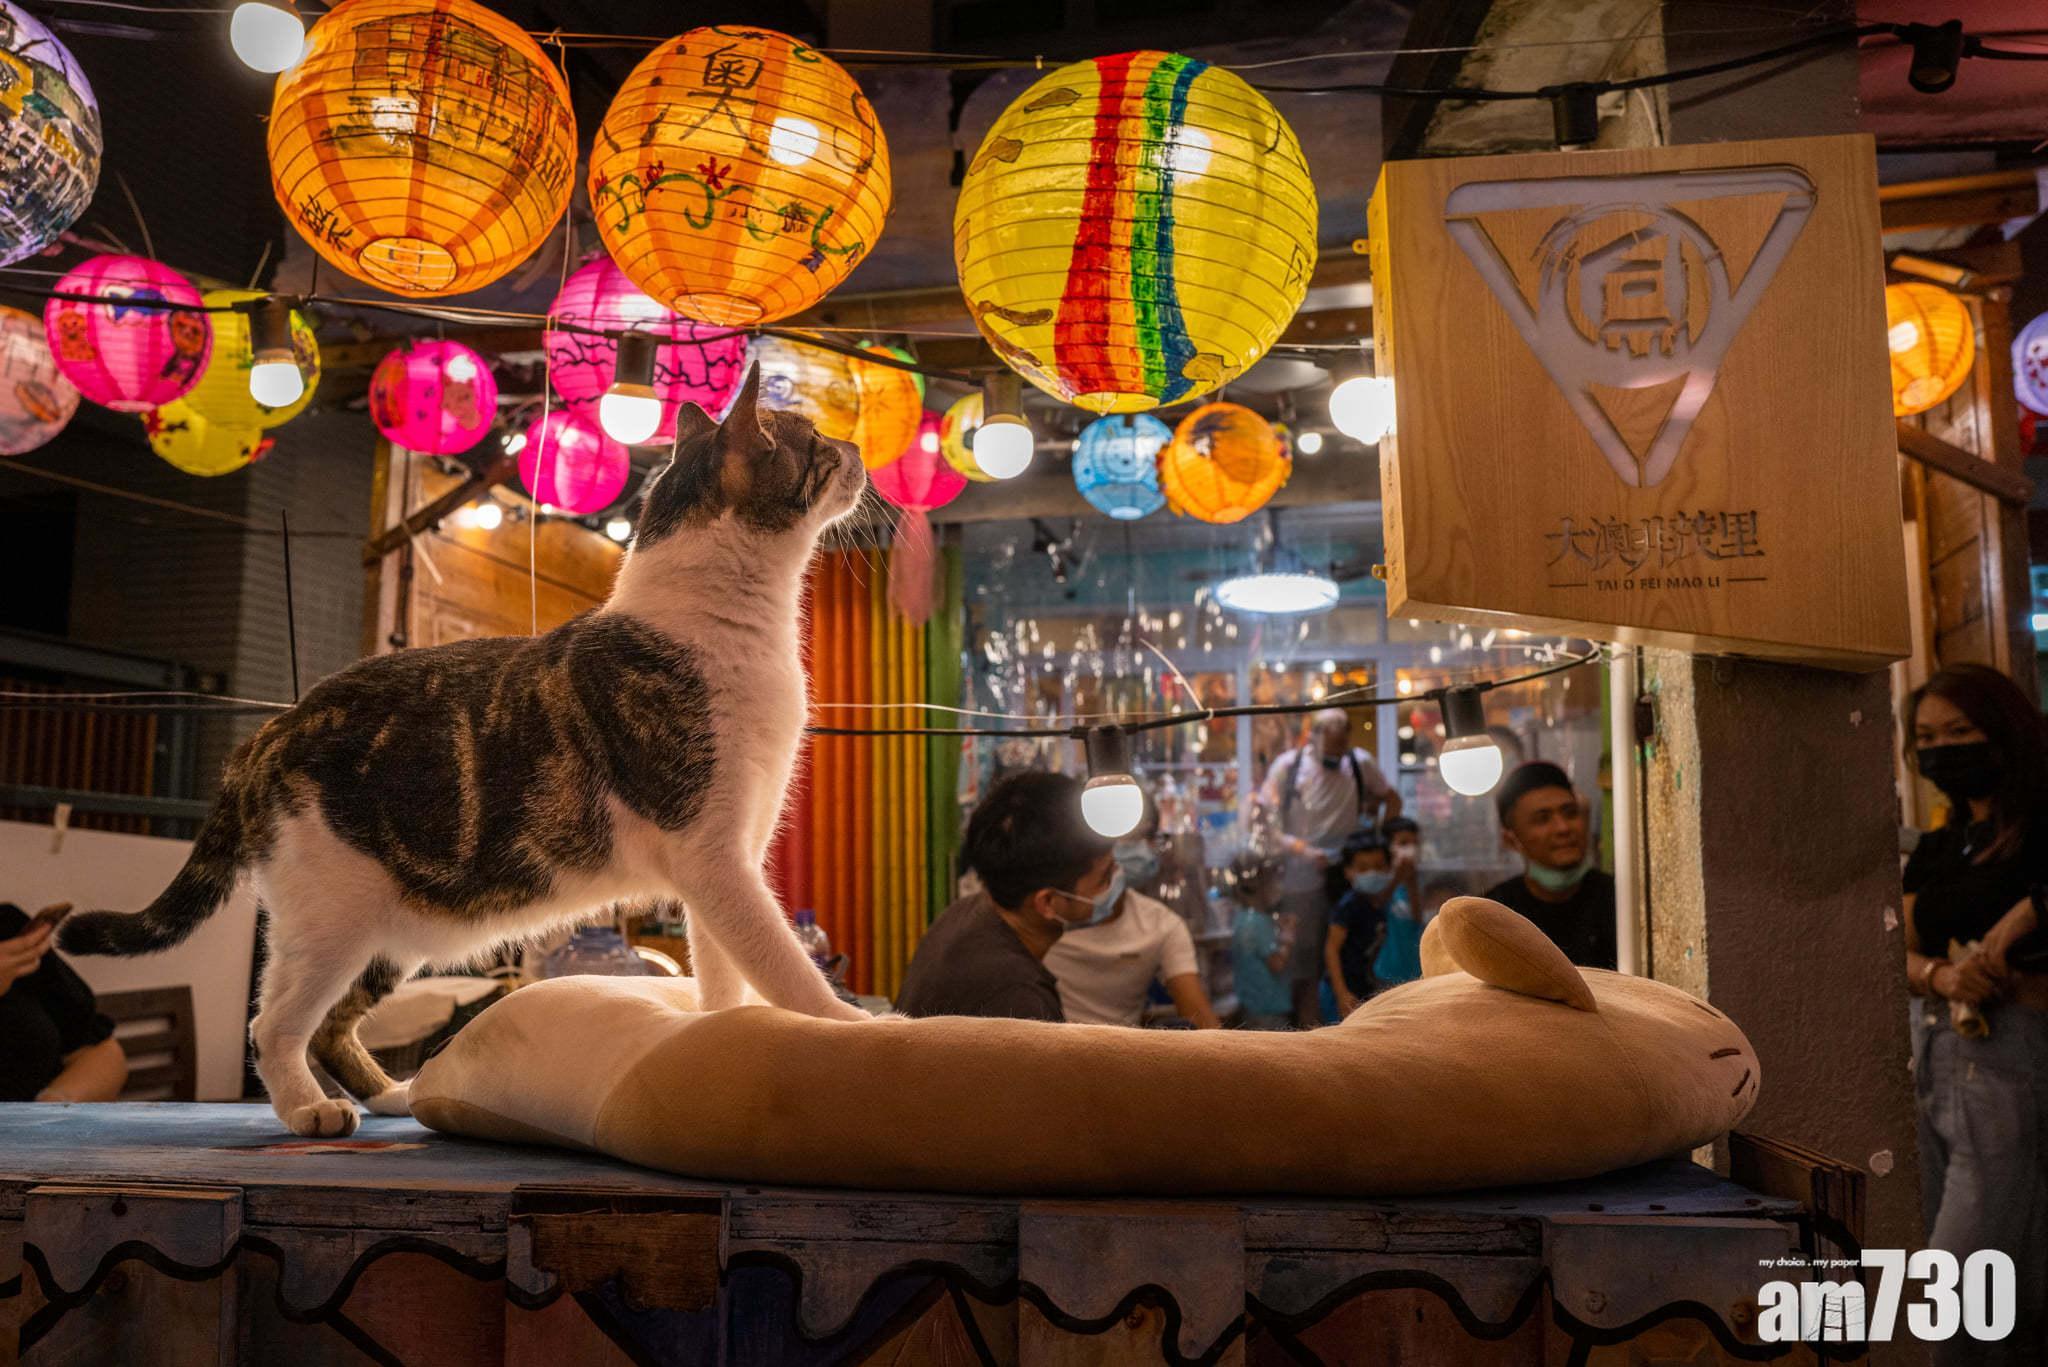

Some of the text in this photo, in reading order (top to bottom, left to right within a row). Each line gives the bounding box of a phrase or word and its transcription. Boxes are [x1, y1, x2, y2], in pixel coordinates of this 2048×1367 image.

[601, 42, 770, 159] 澳
[1596, 575, 1720, 591] TAI O FEI MAO LI
